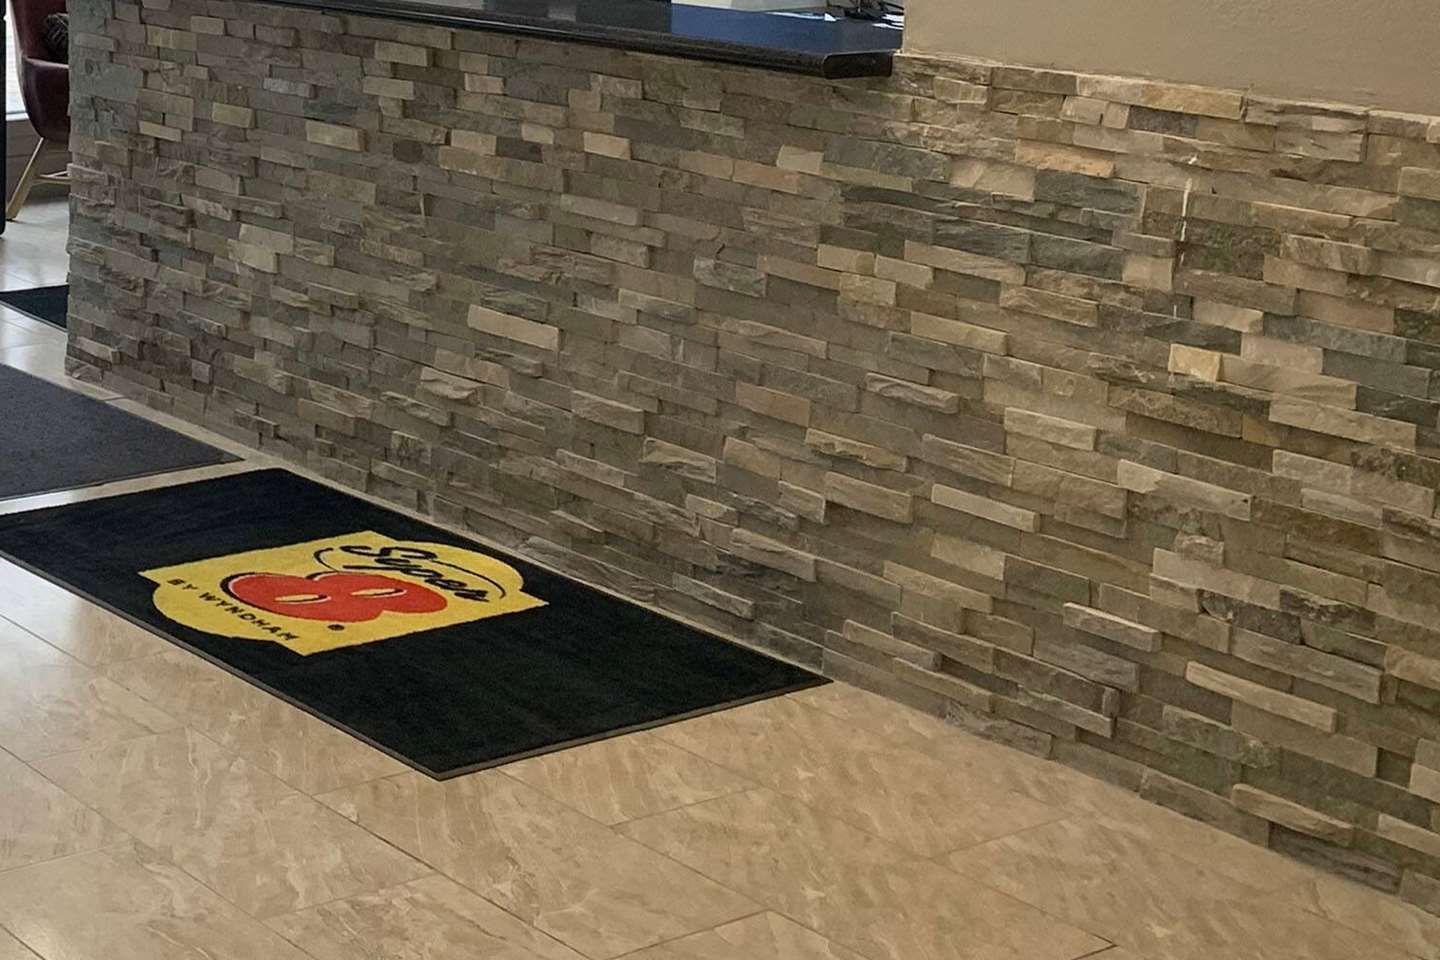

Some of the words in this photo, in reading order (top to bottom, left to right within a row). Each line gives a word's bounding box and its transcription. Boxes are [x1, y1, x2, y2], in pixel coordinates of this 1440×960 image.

[339, 545, 490, 603] Super
[167, 578, 198, 590] BY
[198, 592, 300, 641] WYNDHAM
